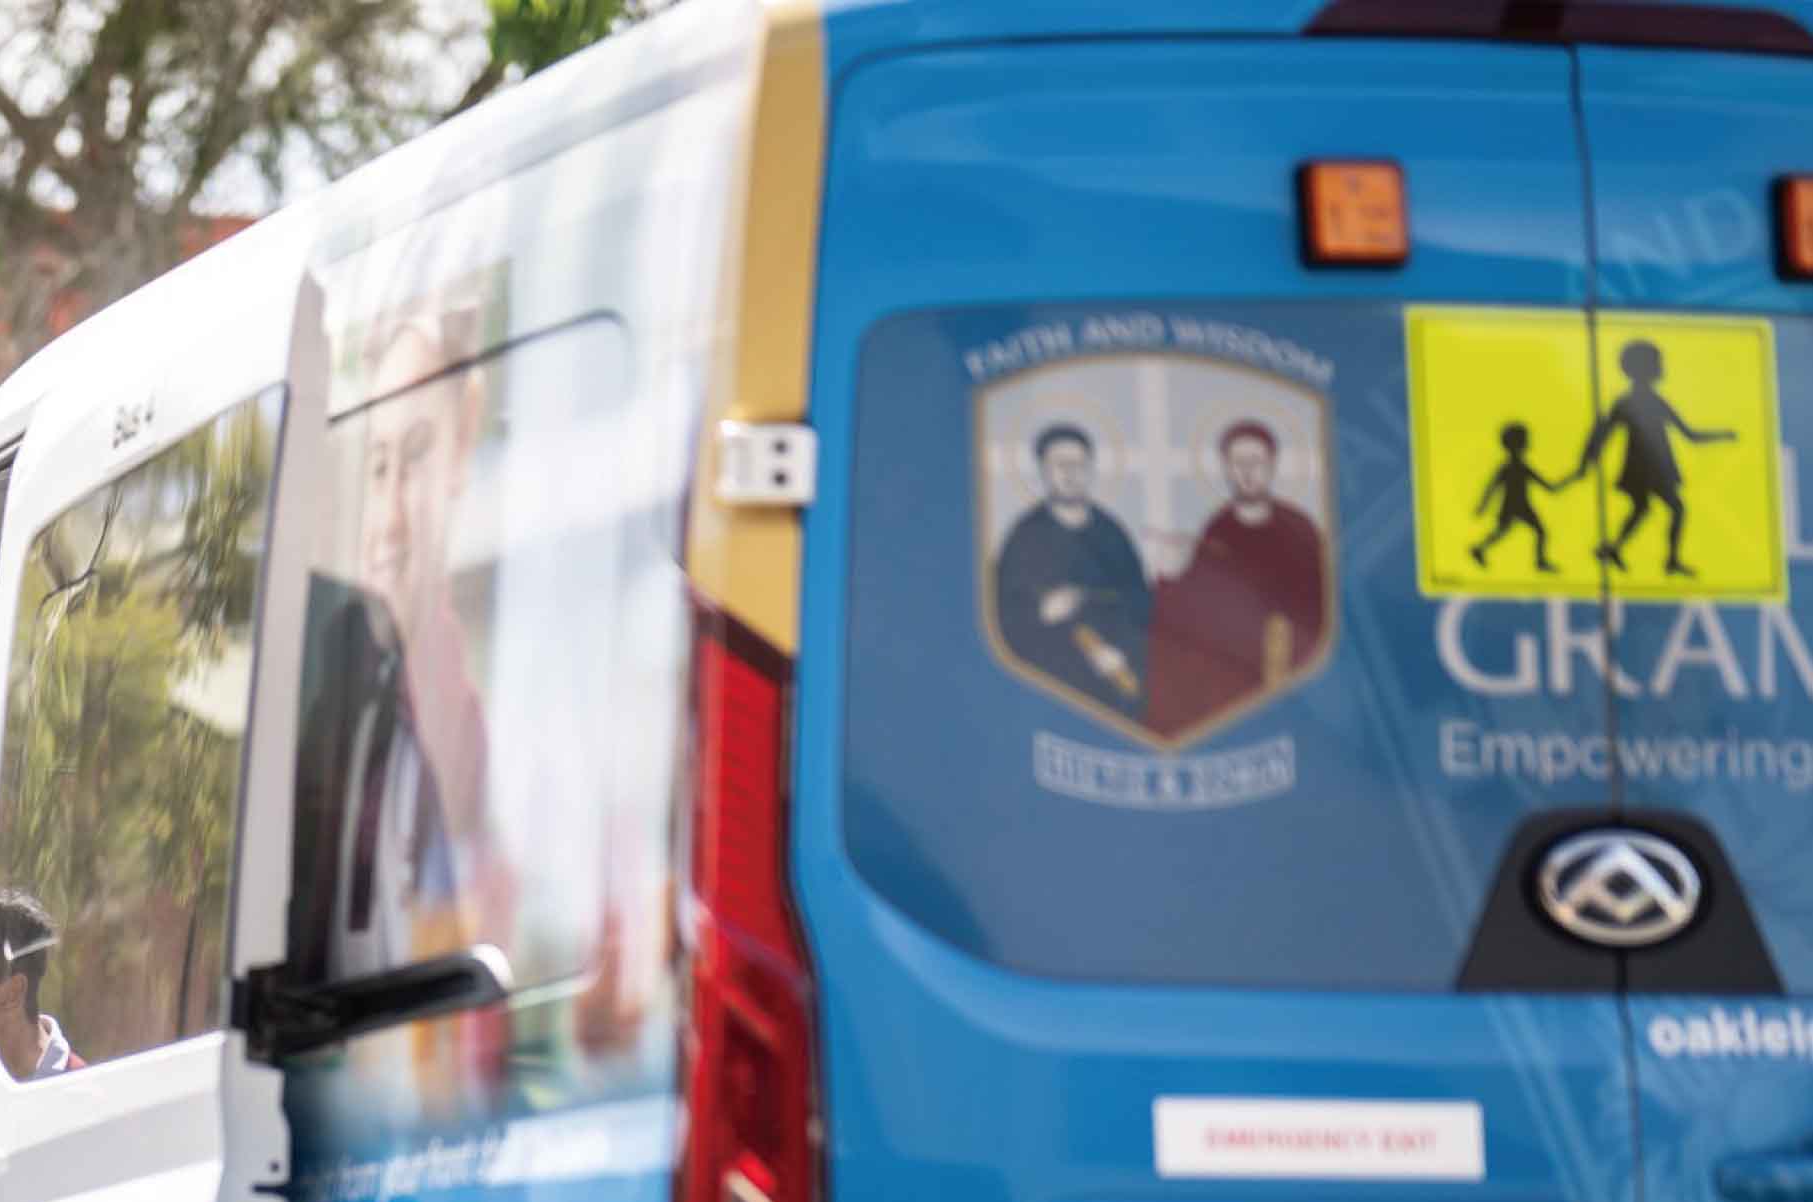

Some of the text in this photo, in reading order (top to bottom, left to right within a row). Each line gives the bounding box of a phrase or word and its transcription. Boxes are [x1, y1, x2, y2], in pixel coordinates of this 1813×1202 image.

[965, 311, 1335, 385] FAITH AND WISDOM
[1438, 720, 1813, 794] Empowering
[1647, 1005, 1813, 1060] oaklei
